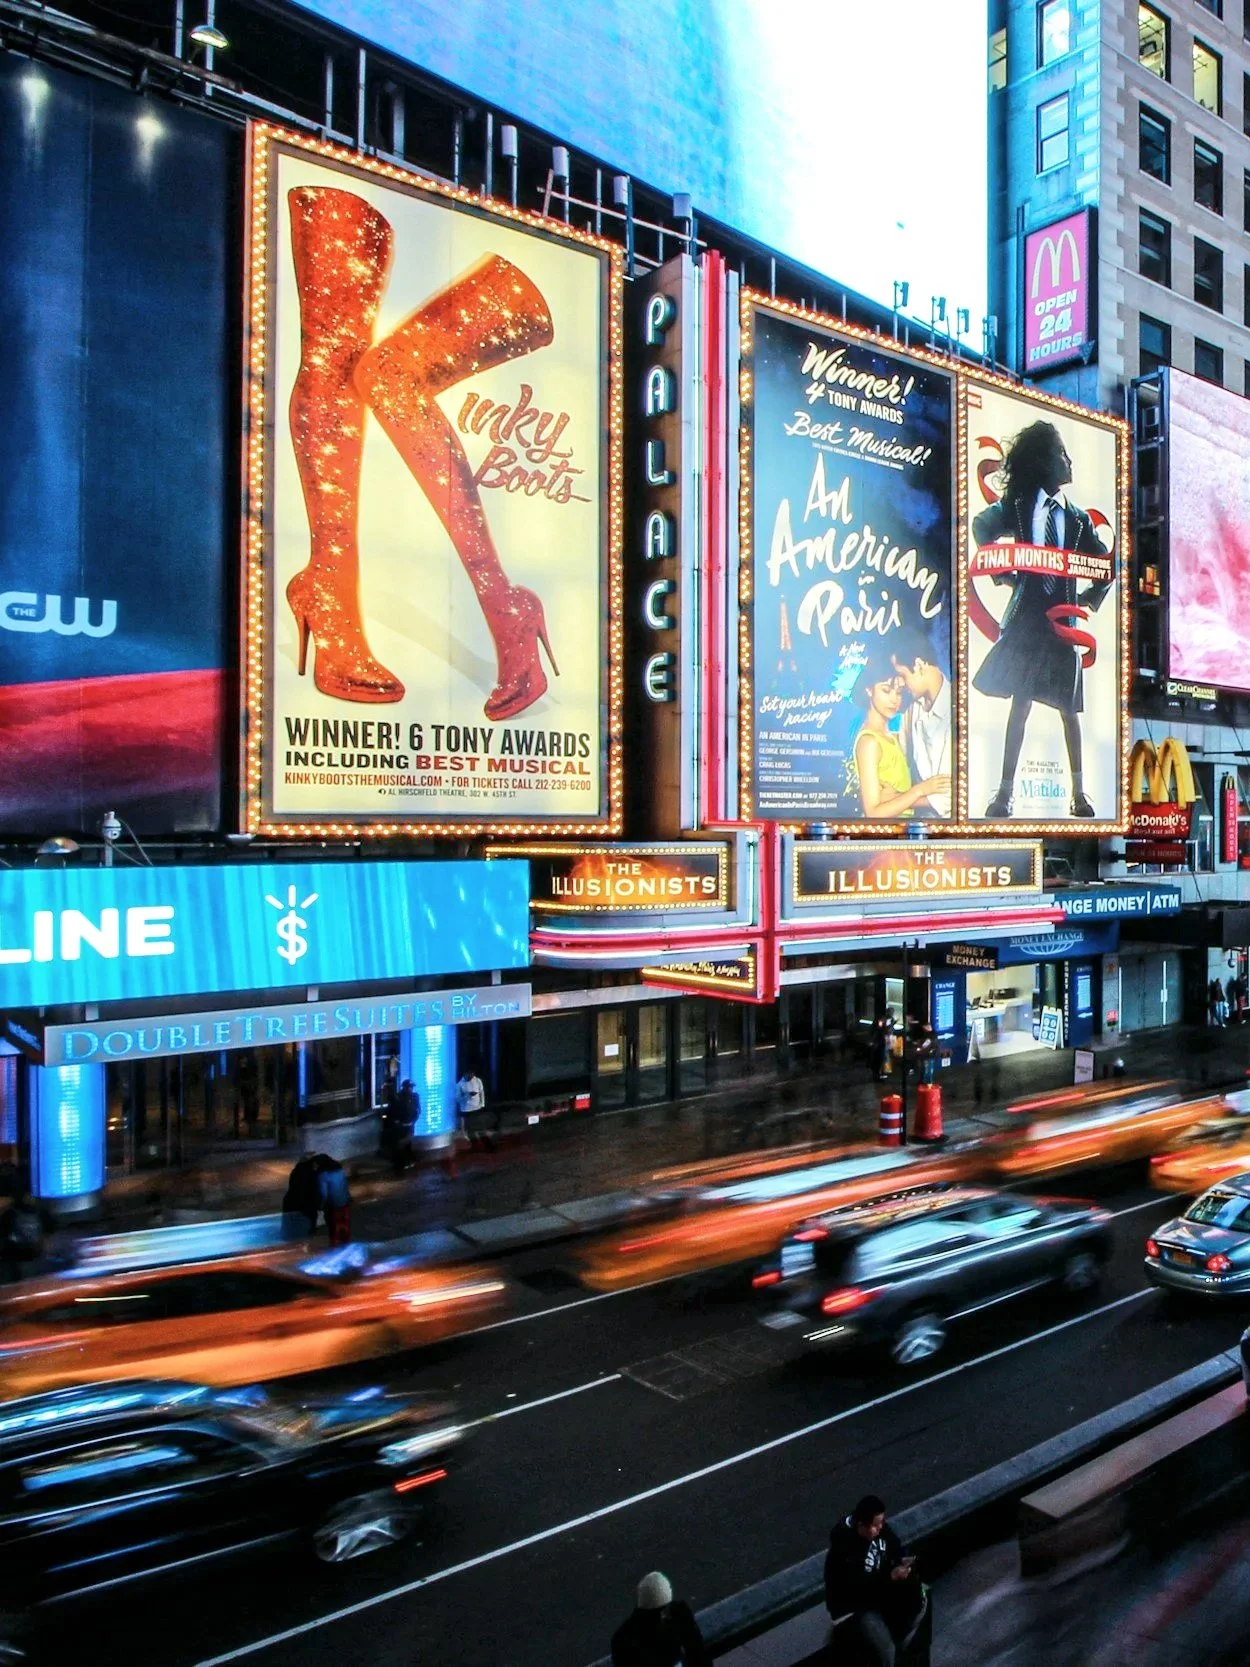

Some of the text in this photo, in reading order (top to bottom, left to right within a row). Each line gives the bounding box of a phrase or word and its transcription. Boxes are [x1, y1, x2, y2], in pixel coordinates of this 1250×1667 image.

[1035, 289, 1077, 316] OPEN
[1039, 307, 1072, 341] 24
[1030, 332, 1082, 361] HOURS
[801, 342, 915, 405] Winner!
[806, 382, 904, 425] 4 TONY AWARDS
[784, 411, 844, 445] Best
[847, 427, 932, 467] Musical!
[472, 446, 592, 505] Boots
[645, 294, 674, 701] PALACE
[804, 452, 853, 524] An
[766, 498, 942, 619] American
[977, 549, 1064, 571] FINAL MONTHS
[1068, 553, 1111, 567] SEE IT BEFORE
[858, 570, 875, 586] in
[1068, 564, 1111, 579] JANUARY 1
[12, 607, 36, 617] THE
[797, 580, 902, 647] Paris
[760, 691, 843, 718] Set your heart
[783, 709, 832, 728] racing
[285, 717, 591, 758] WINNER! 6 TONY AWARDS
[759, 731, 768, 740] AN
[769, 732, 801, 741] AMERICAN
[286, 751, 591, 775] INCLUDING BEST MUSICAL
[285, 772, 591, 791] KINKYBOOTSTHEMUSICAL.COM FOR TICKETS CALL 212-239-6200
[1020, 779, 1066, 798] Matilda
[914, 851, 945, 865] THE
[606, 863, 642, 876] THE
[828, 866, 1012, 893] ILLUSIONISTS
[552, 875, 717, 897] ILLUSIONISTS
[1096, 896, 1145, 913] MONEY
[1152, 894, 1179, 909] ATM
[1010, 931, 1084, 945] MONEY EXCHANGE
[946, 954, 996, 969] EXCHANGE
[952, 945, 985, 958] MONEY
[452, 995, 476, 1007] BY
[452, 1002, 520, 1018] HILTON
